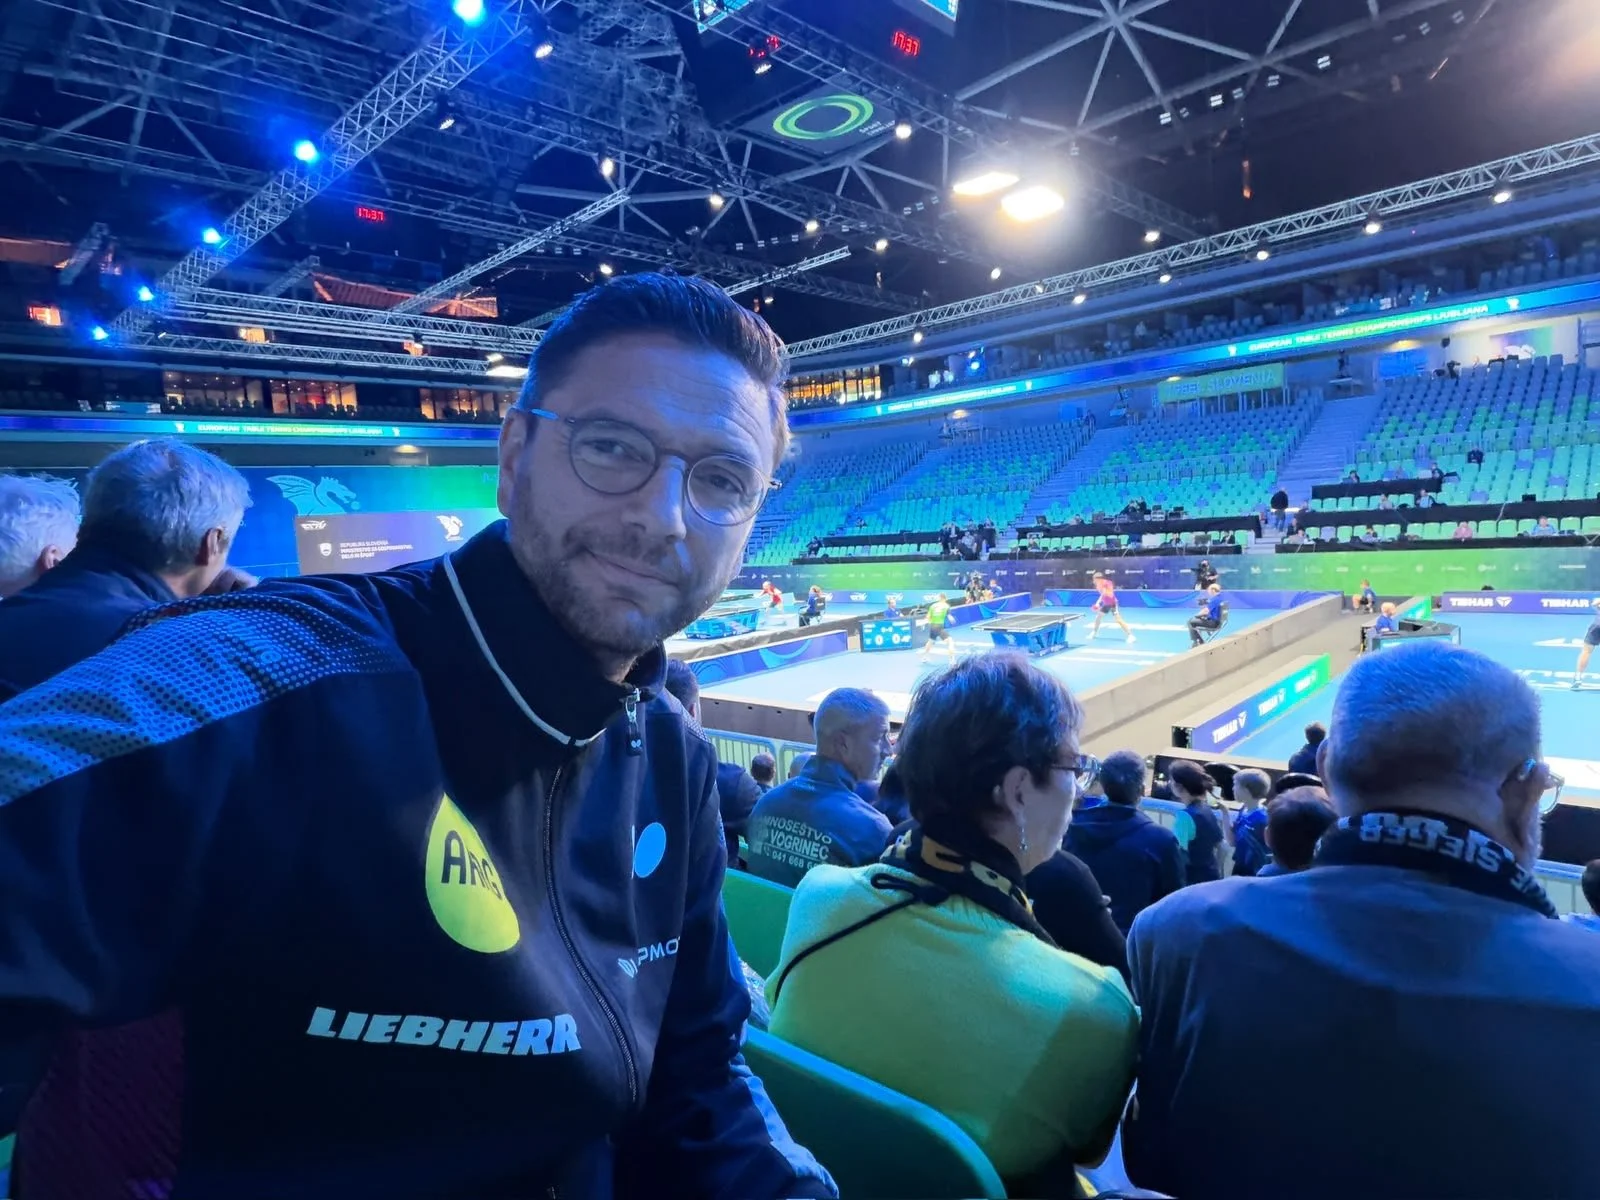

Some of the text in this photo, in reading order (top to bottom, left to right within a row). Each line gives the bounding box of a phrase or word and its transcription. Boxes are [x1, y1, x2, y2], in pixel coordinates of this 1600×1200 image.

[1432, 305, 1489, 320] LJUBLJANA
[1208, 369, 1276, 391] SLOVENIA
[1449, 597, 1494, 607] TIBHAR
[770, 829, 829, 860] VOGRINEC
[306, 1006, 582, 1056] LIEBHERR
